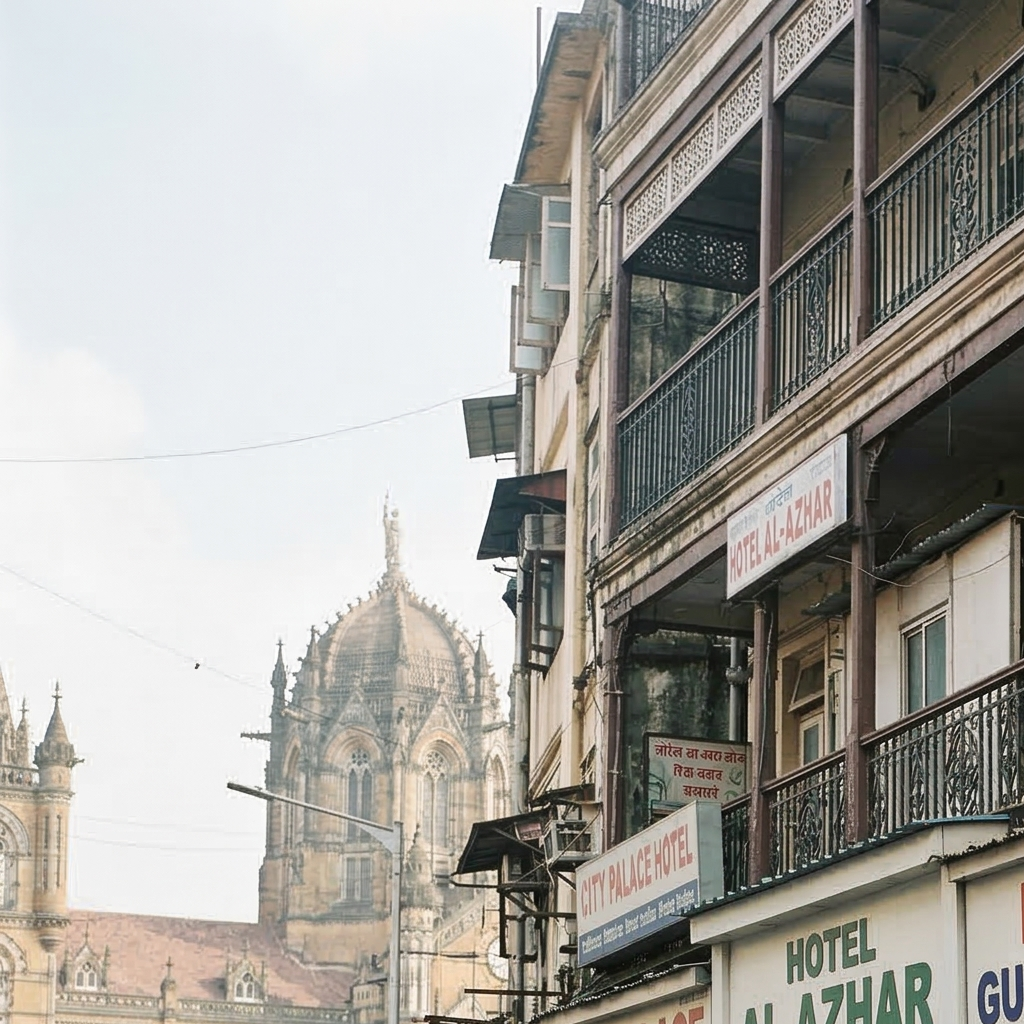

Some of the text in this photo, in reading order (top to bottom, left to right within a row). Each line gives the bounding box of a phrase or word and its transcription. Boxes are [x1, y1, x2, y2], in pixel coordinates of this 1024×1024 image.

[729, 528, 762, 583] HOTEL
[764, 479, 833, 561] AL-AZHAR
[581, 823, 693, 919] CITY PALACE HOTEL
[786, 917, 877, 985] HOTEL
